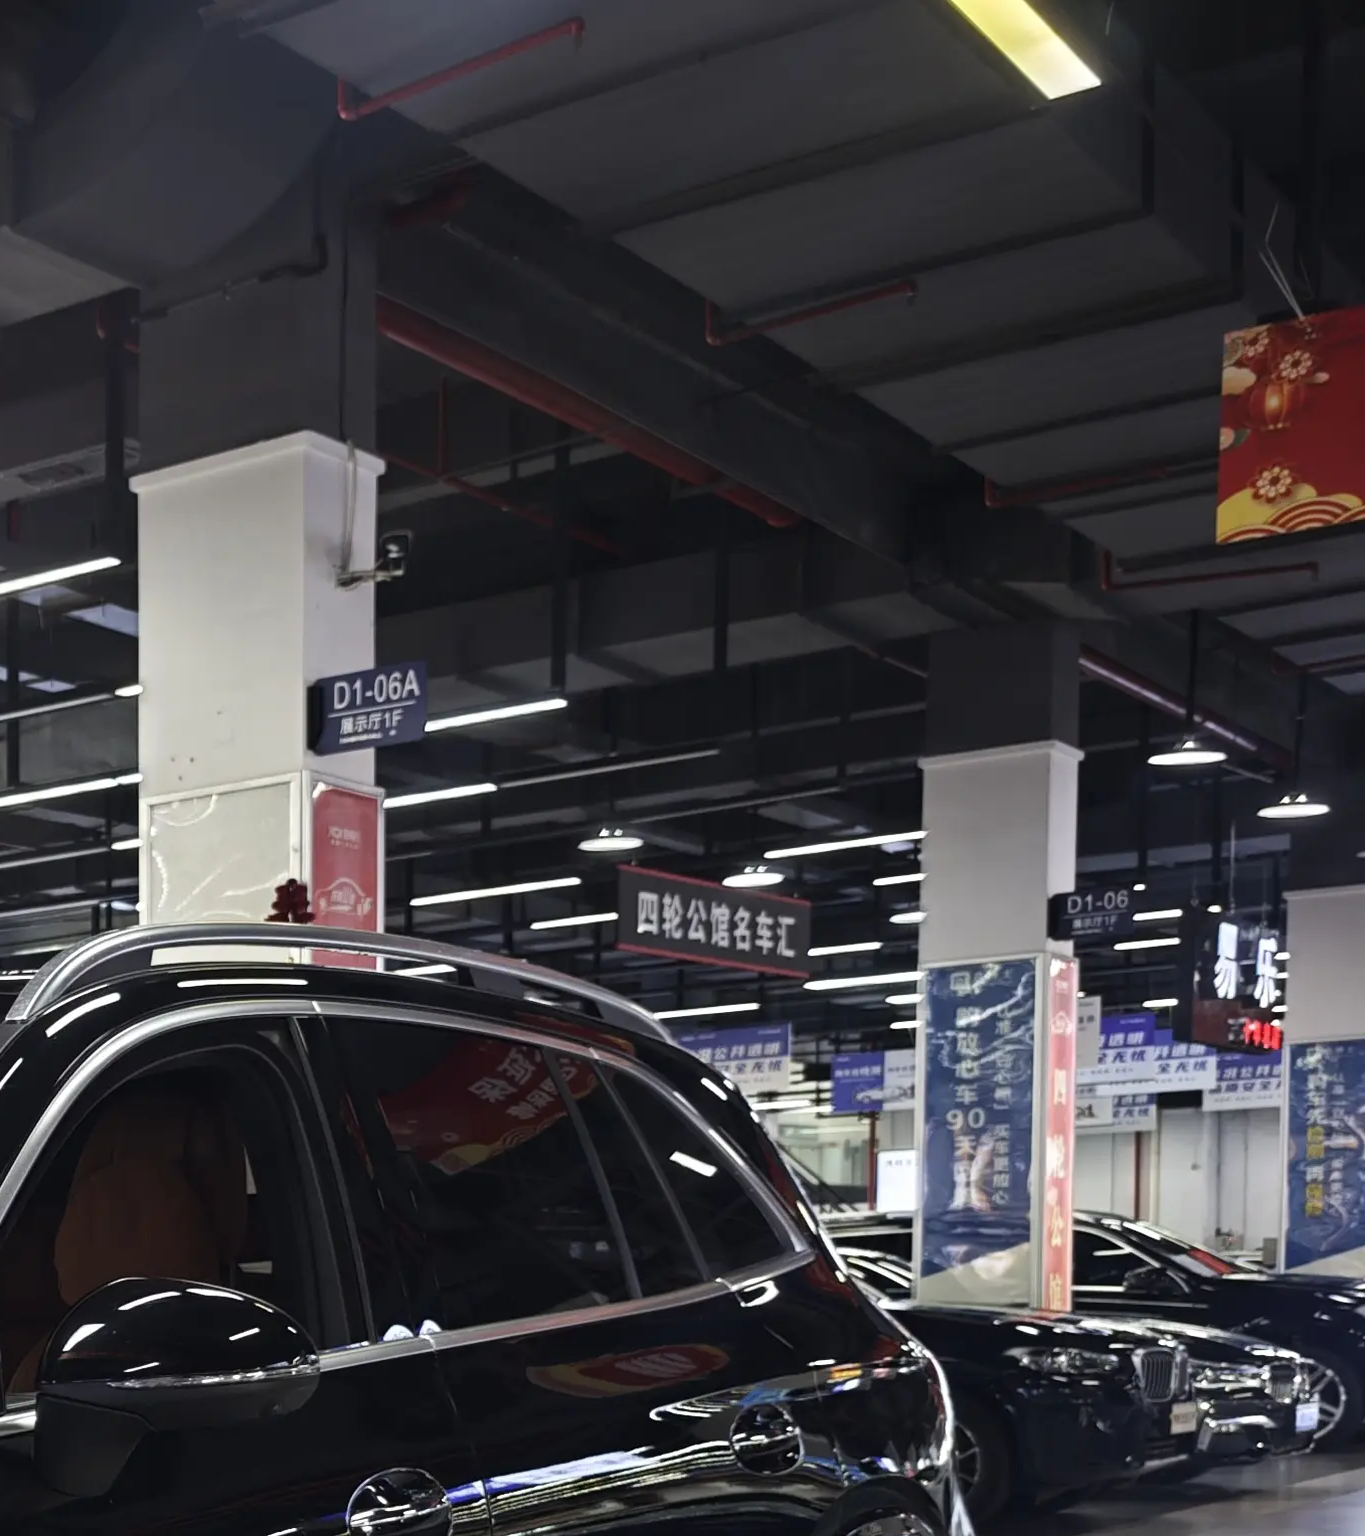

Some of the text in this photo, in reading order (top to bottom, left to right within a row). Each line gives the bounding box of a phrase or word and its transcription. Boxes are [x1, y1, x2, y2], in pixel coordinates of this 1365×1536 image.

[333, 669, 421, 710] D1-06A
[1067, 889, 1129, 914] D1-06
[637, 890, 796, 958] 四轮公馆名车汇
